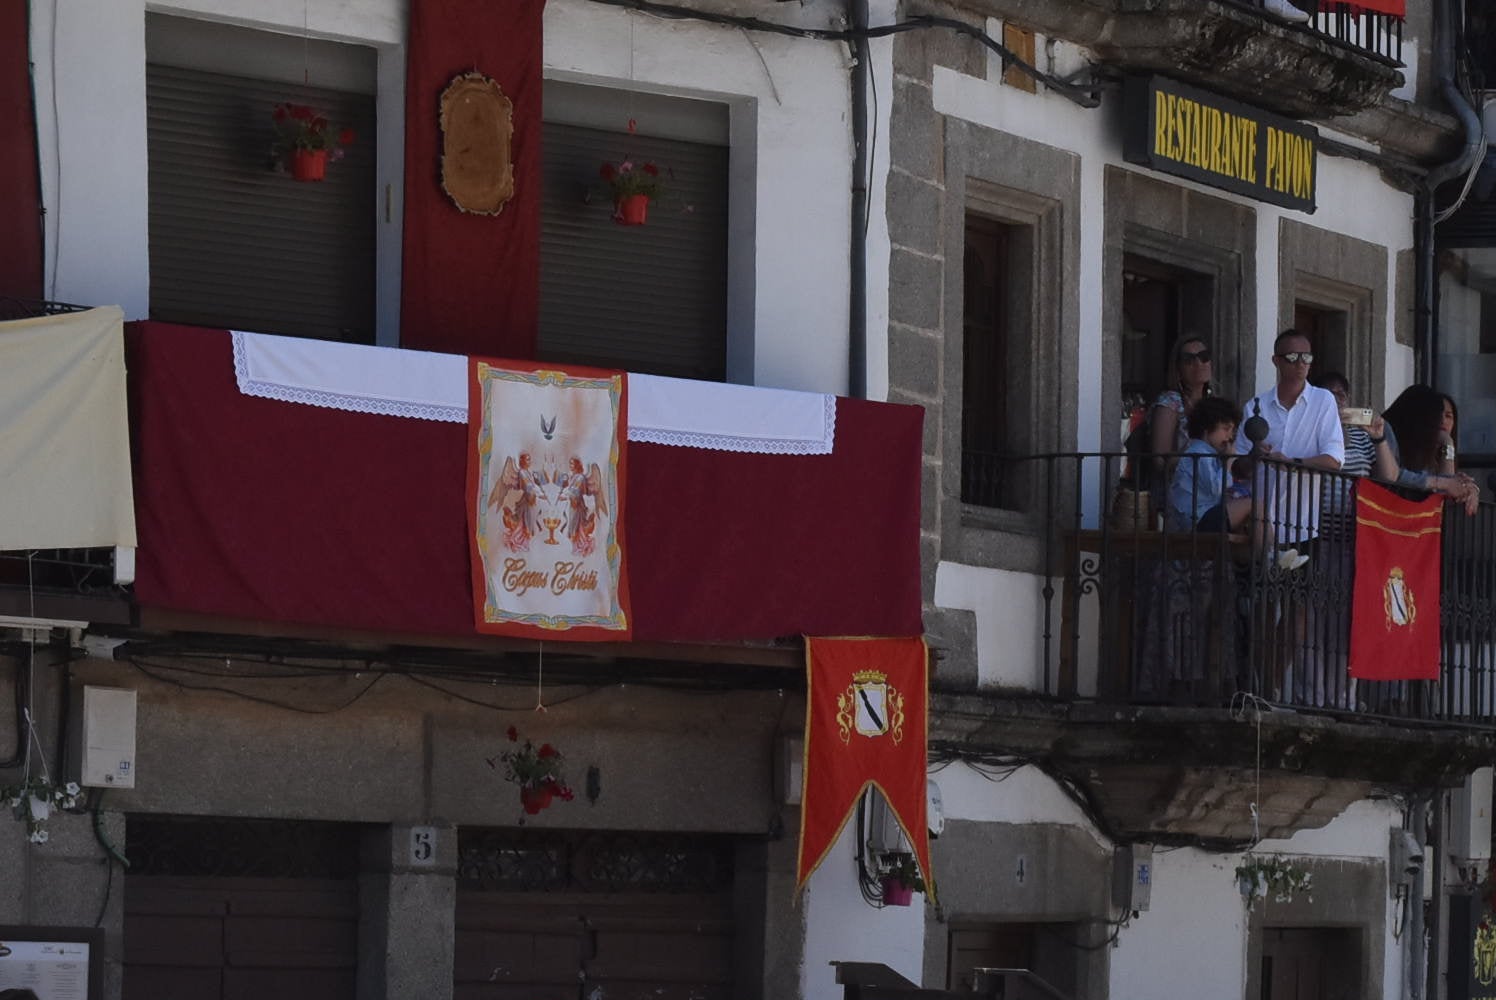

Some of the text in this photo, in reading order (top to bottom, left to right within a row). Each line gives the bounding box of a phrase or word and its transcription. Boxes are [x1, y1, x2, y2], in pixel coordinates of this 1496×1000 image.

[1154, 90, 1313, 200] RESTAURANTE PAVON
[551, 561, 599, 596] Christi
[414, 833, 431, 860] 5
